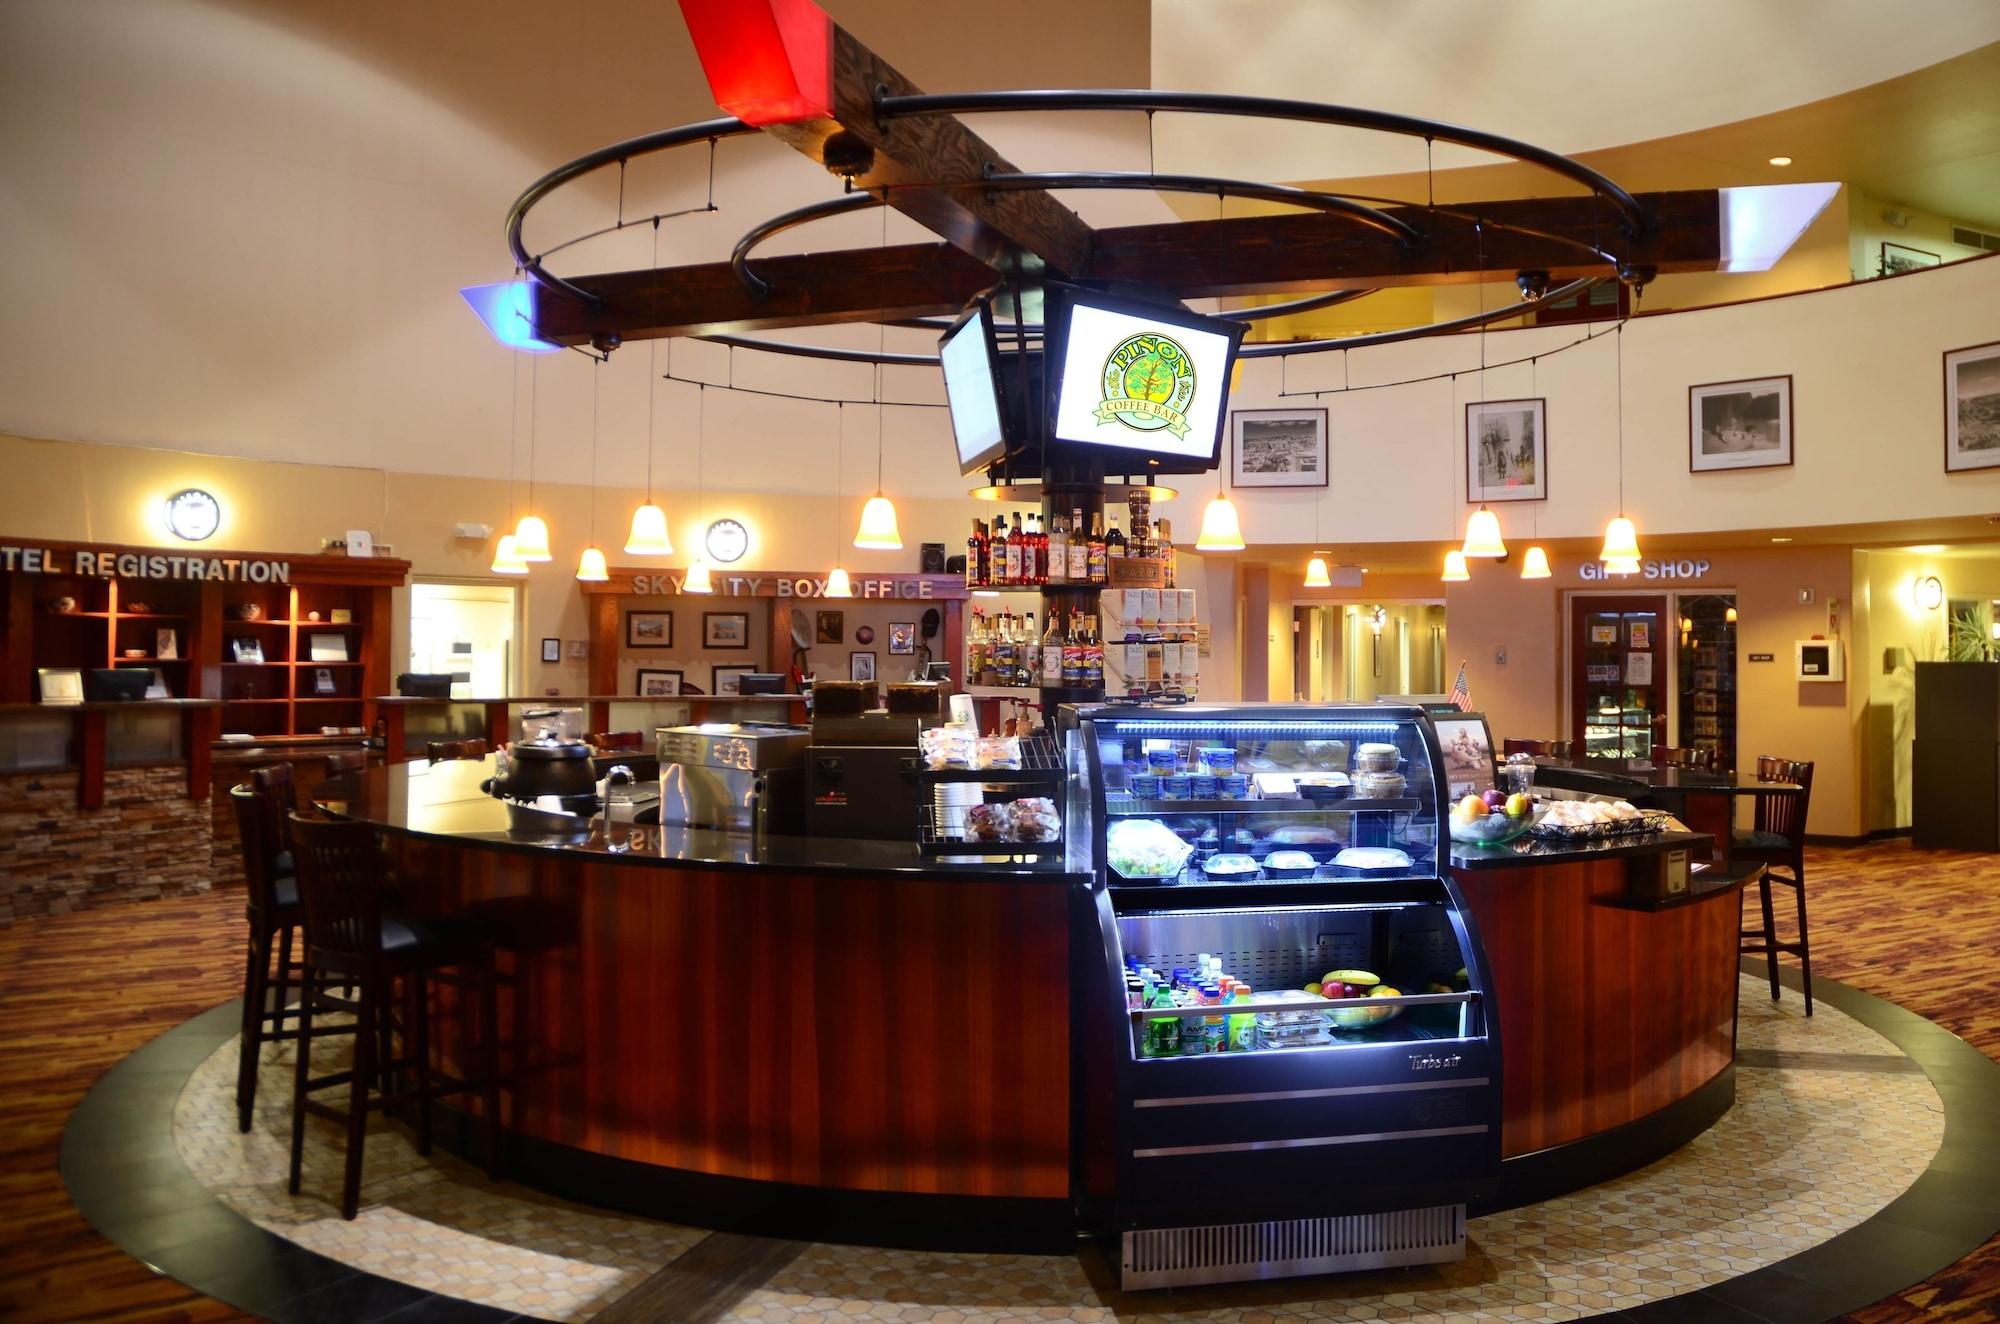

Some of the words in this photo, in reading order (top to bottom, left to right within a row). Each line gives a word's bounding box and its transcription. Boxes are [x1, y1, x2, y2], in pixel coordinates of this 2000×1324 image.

[1106, 400, 1150, 412] COFFEE
[1153, 404, 1178, 423] BAR
[0, 546, 61, 573] TEL
[76, 551, 289, 583] REGISTRATION
[1580, 562, 1628, 580] GI
[1644, 560, 1710, 579] SHOP
[633, 575, 685, 596] SKY
[777, 578, 827, 599] BOX
[1444, 1053, 1461, 1067] air
